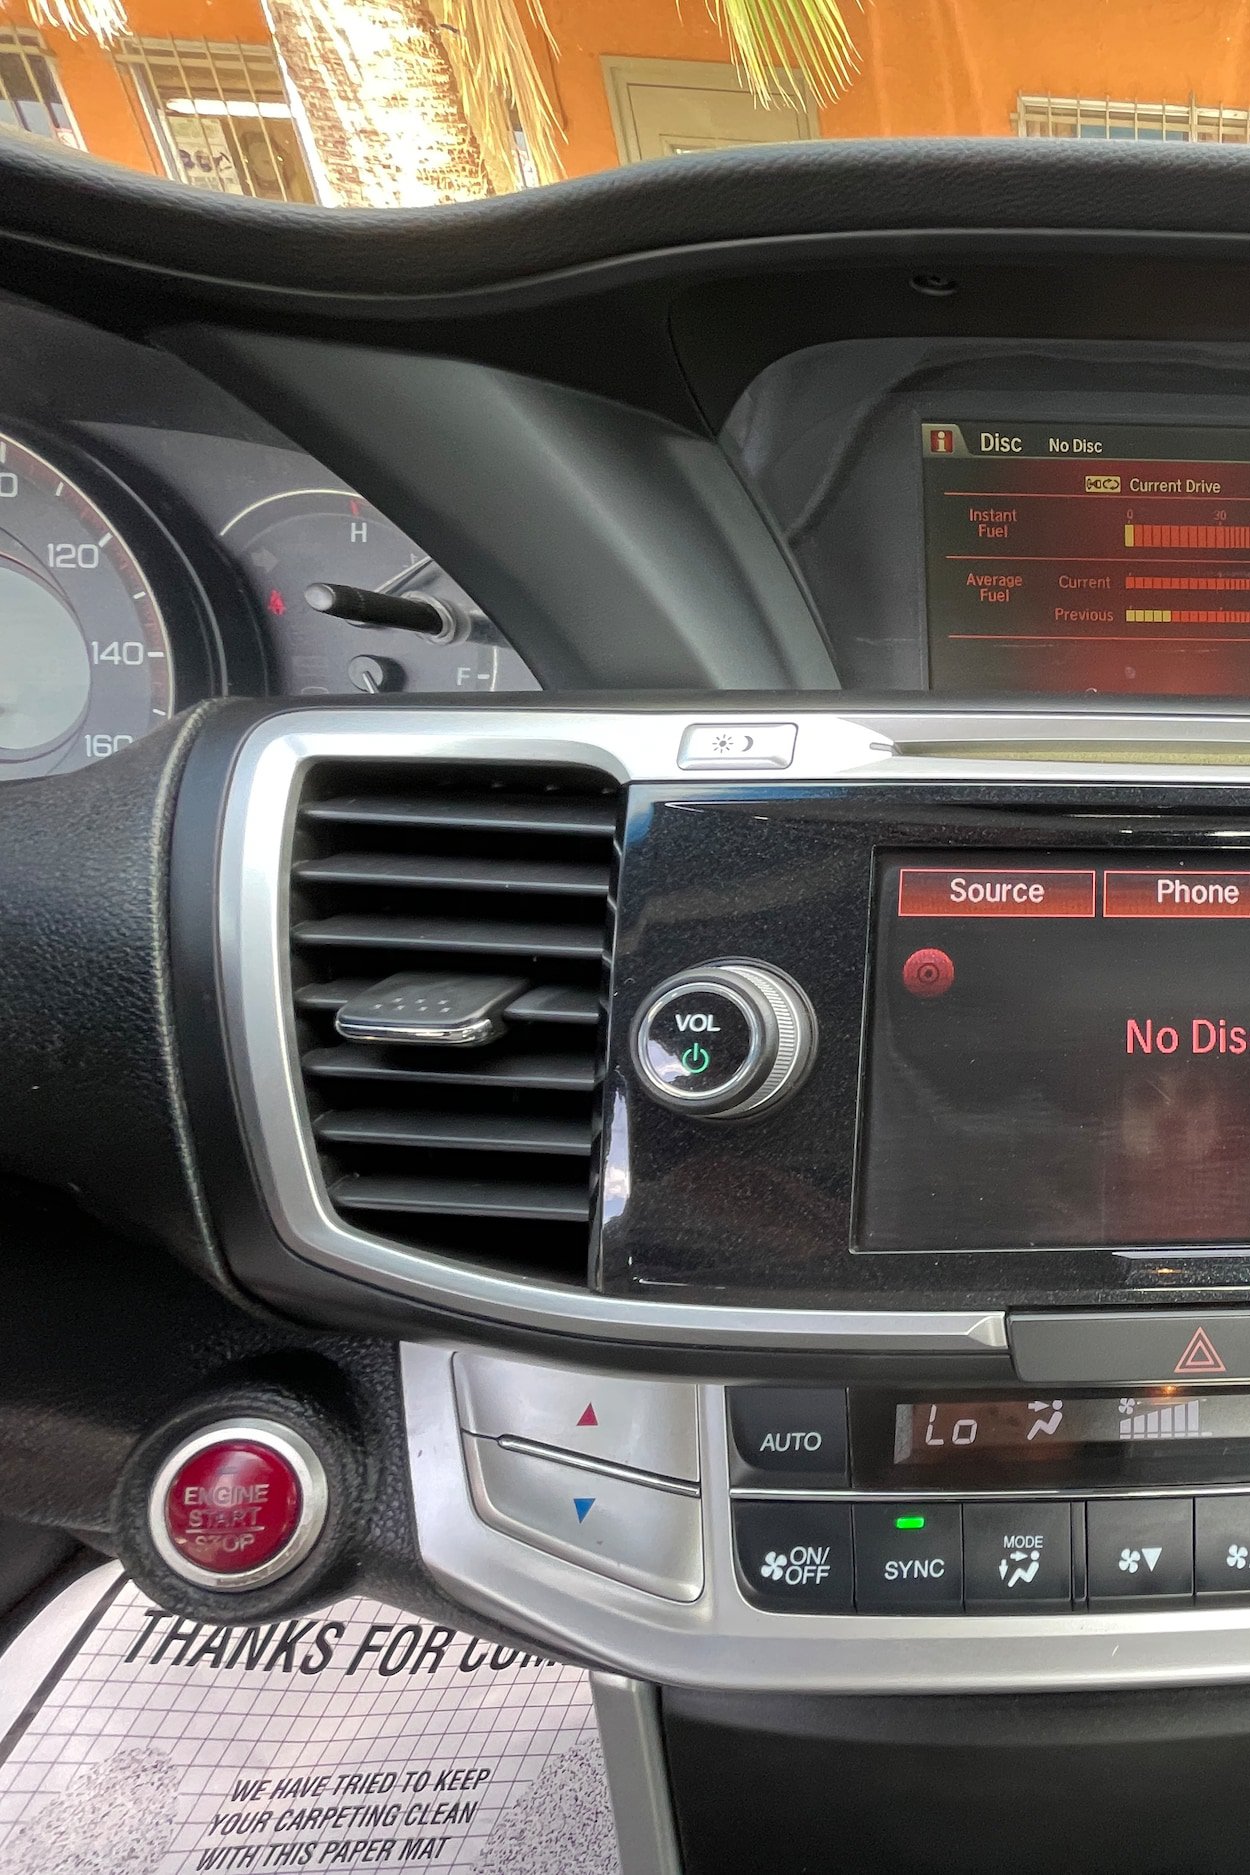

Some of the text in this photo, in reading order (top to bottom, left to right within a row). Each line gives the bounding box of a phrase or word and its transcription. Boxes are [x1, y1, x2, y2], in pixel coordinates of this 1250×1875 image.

[980, 432, 1022, 453] Disc
[1049, 438, 1103, 453] No Disc
[1129, 478, 1221, 493] Current Drive
[969, 508, 1018, 522] Instant
[1126, 509, 1134, 520] 0
[1214, 510, 1227, 521] 30
[350, 522, 367, 543] H
[978, 523, 1009, 538] Fuel
[47, 543, 100, 569] 120
[966, 573, 1023, 588] Average
[1058, 575, 1111, 589] Current
[979, 588, 1010, 602] Fuel
[1054, 607, 1114, 622] Previous
[91, 641, 144, 666] 140
[456, 667, 471, 686] F
[949, 878, 1045, 905] Source
[1156, 879, 1240, 905] Phone
[675, 1013, 721, 1033] VOL
[1126, 1019, 1179, 1055] No
[760, 1432, 822, 1452] AUTO
[183, 1483, 270, 1507] ENGINE
[188, 1506, 262, 1528] START
[1003, 1536, 1043, 1548] MODE
[785, 1565, 831, 1585] OFF
[884, 1560, 945, 1579] SYNC
[124, 1610, 350, 1675] THANKS
[346, 1624, 456, 1677] FOR
[231, 1768, 491, 1802] WE HAVE TRIED TO KEEP
[208, 1801, 478, 1836] YOUR CARPETING CLEAN
[196, 1837, 451, 1872] WITH THIS PAPER MAT
